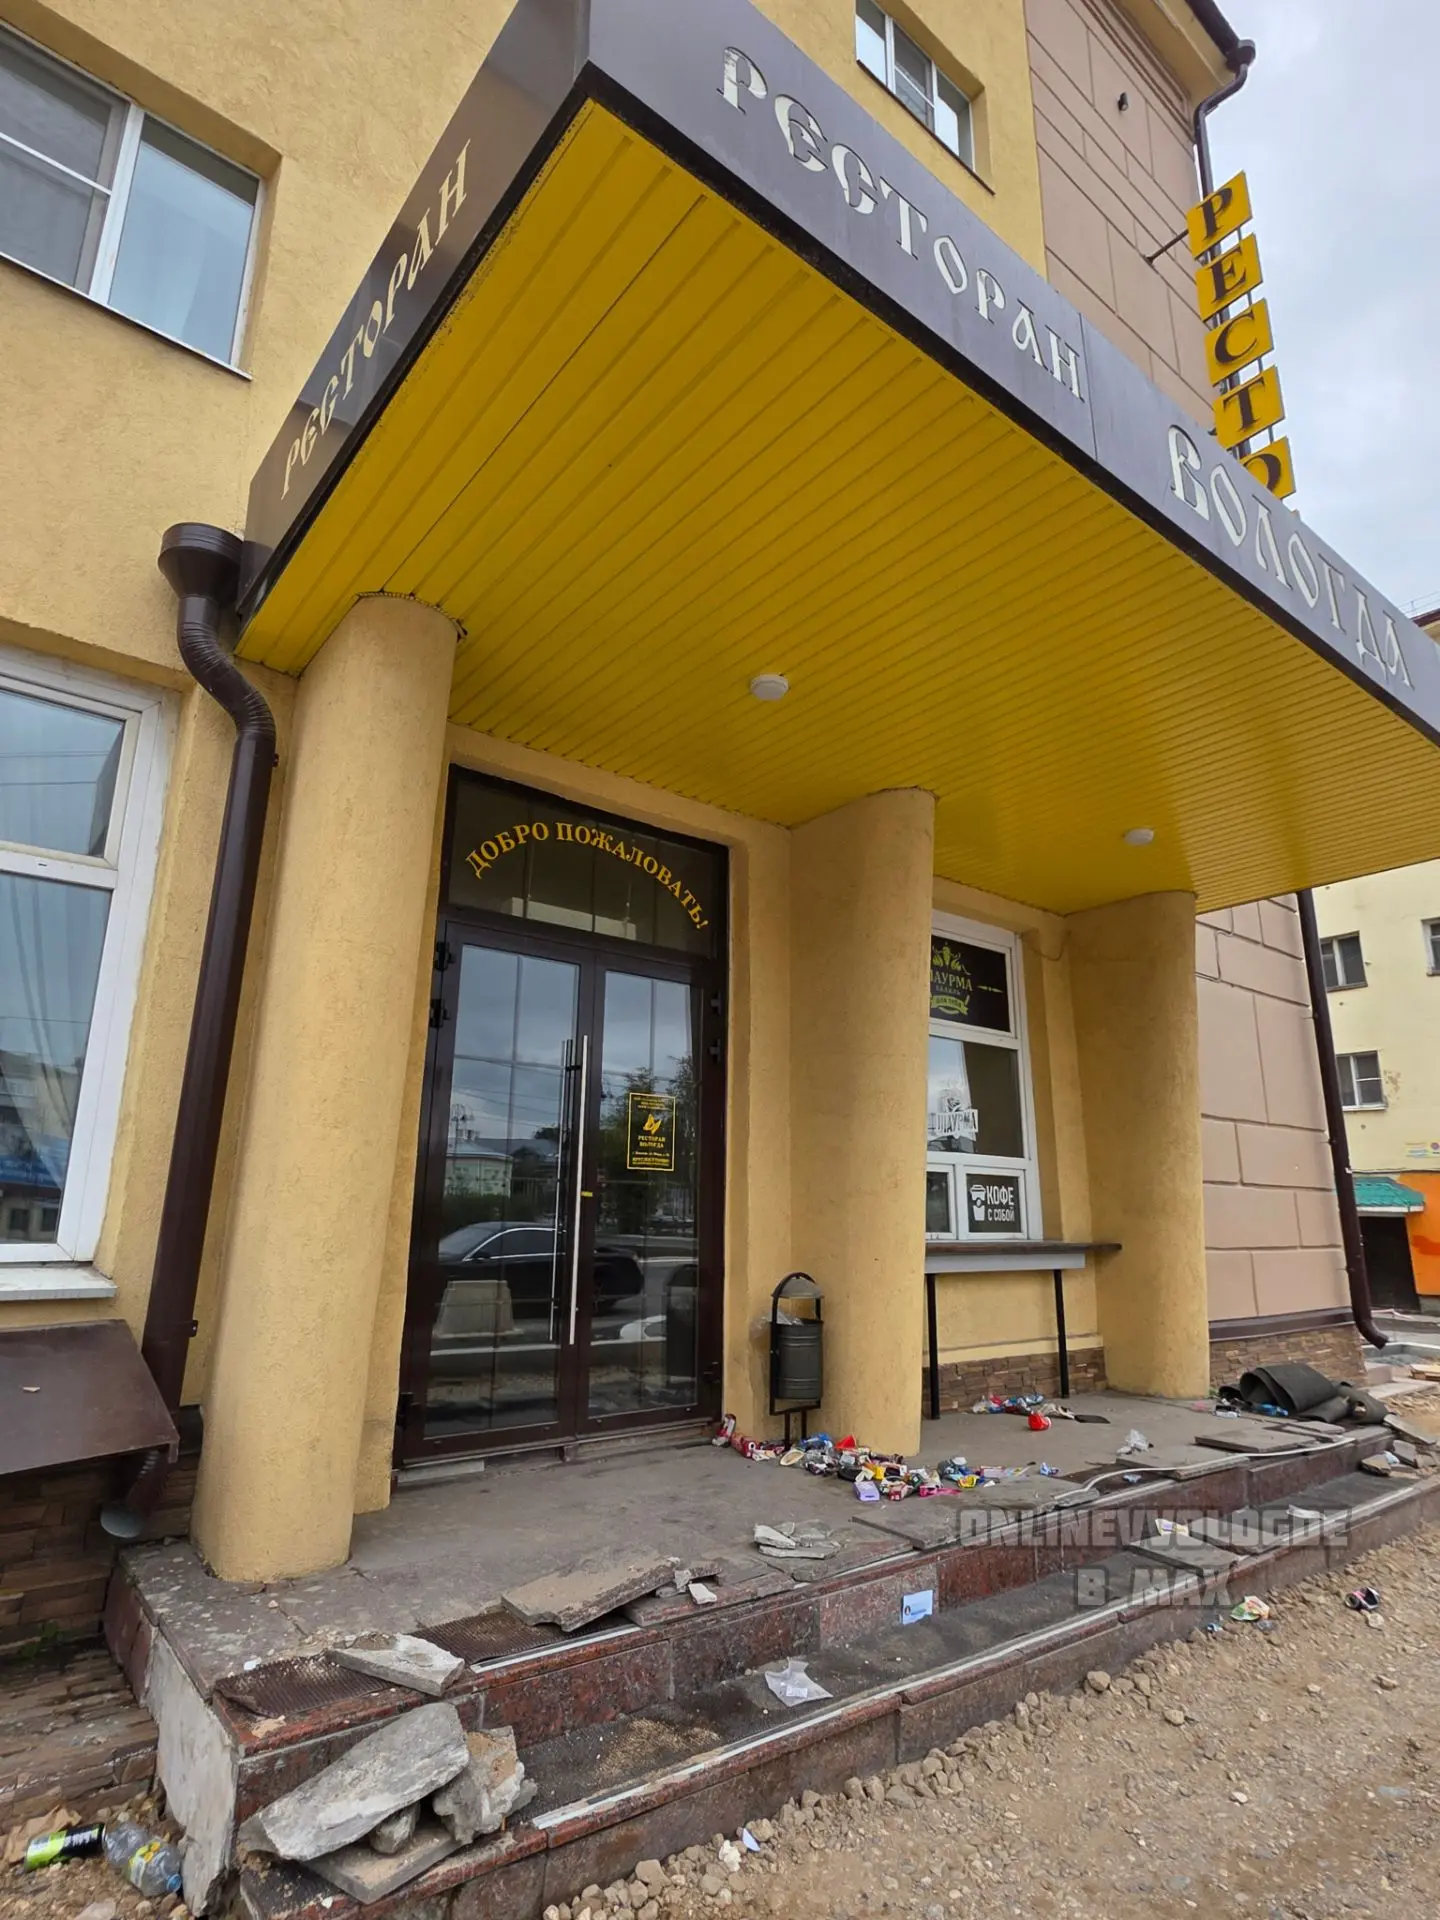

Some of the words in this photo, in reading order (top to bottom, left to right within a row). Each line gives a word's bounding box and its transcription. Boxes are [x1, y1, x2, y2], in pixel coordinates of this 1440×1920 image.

[716, 46, 1085, 403] РЕСТОРАН
[281, 138, 471, 501] РЕСТОРАН
[1167, 424, 1415, 691] ВОЛОГДА
[464, 822, 550, 880] ДОБРО
[556, 822, 709, 930] ПОЖАЛОВАТЬ!
[986, 1185, 1015, 1206] КОФЕ
[987, 1208, 993, 1221] С
[993, 1207, 1015, 1222] СОБОЙ
